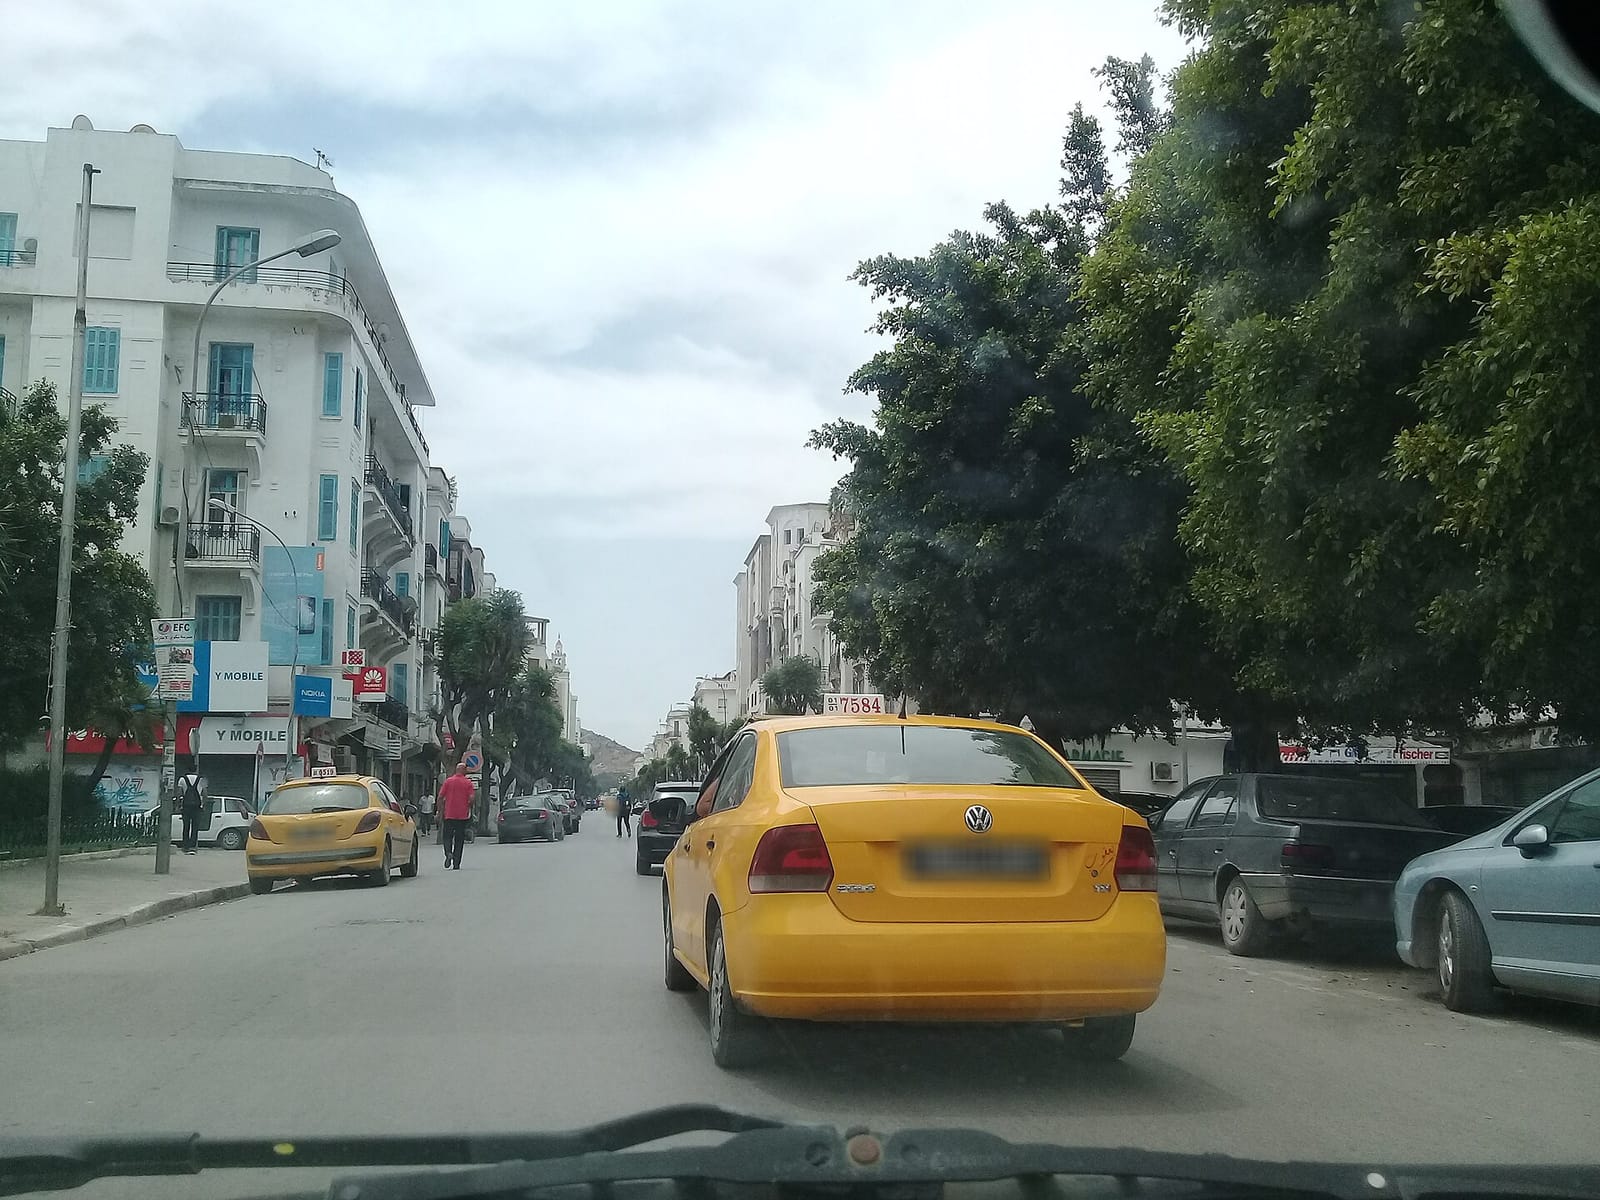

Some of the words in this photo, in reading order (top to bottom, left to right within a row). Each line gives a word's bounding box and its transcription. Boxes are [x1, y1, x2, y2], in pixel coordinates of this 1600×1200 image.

[173, 623, 190, 632] EFC
[215, 672, 222, 680] Y
[224, 672, 263, 681] MOBILE
[301, 689, 326, 697] NOKIA
[840, 697, 881, 713] 7584
[216, 730, 226, 740] Y
[230, 730, 287, 741] MOBILE
